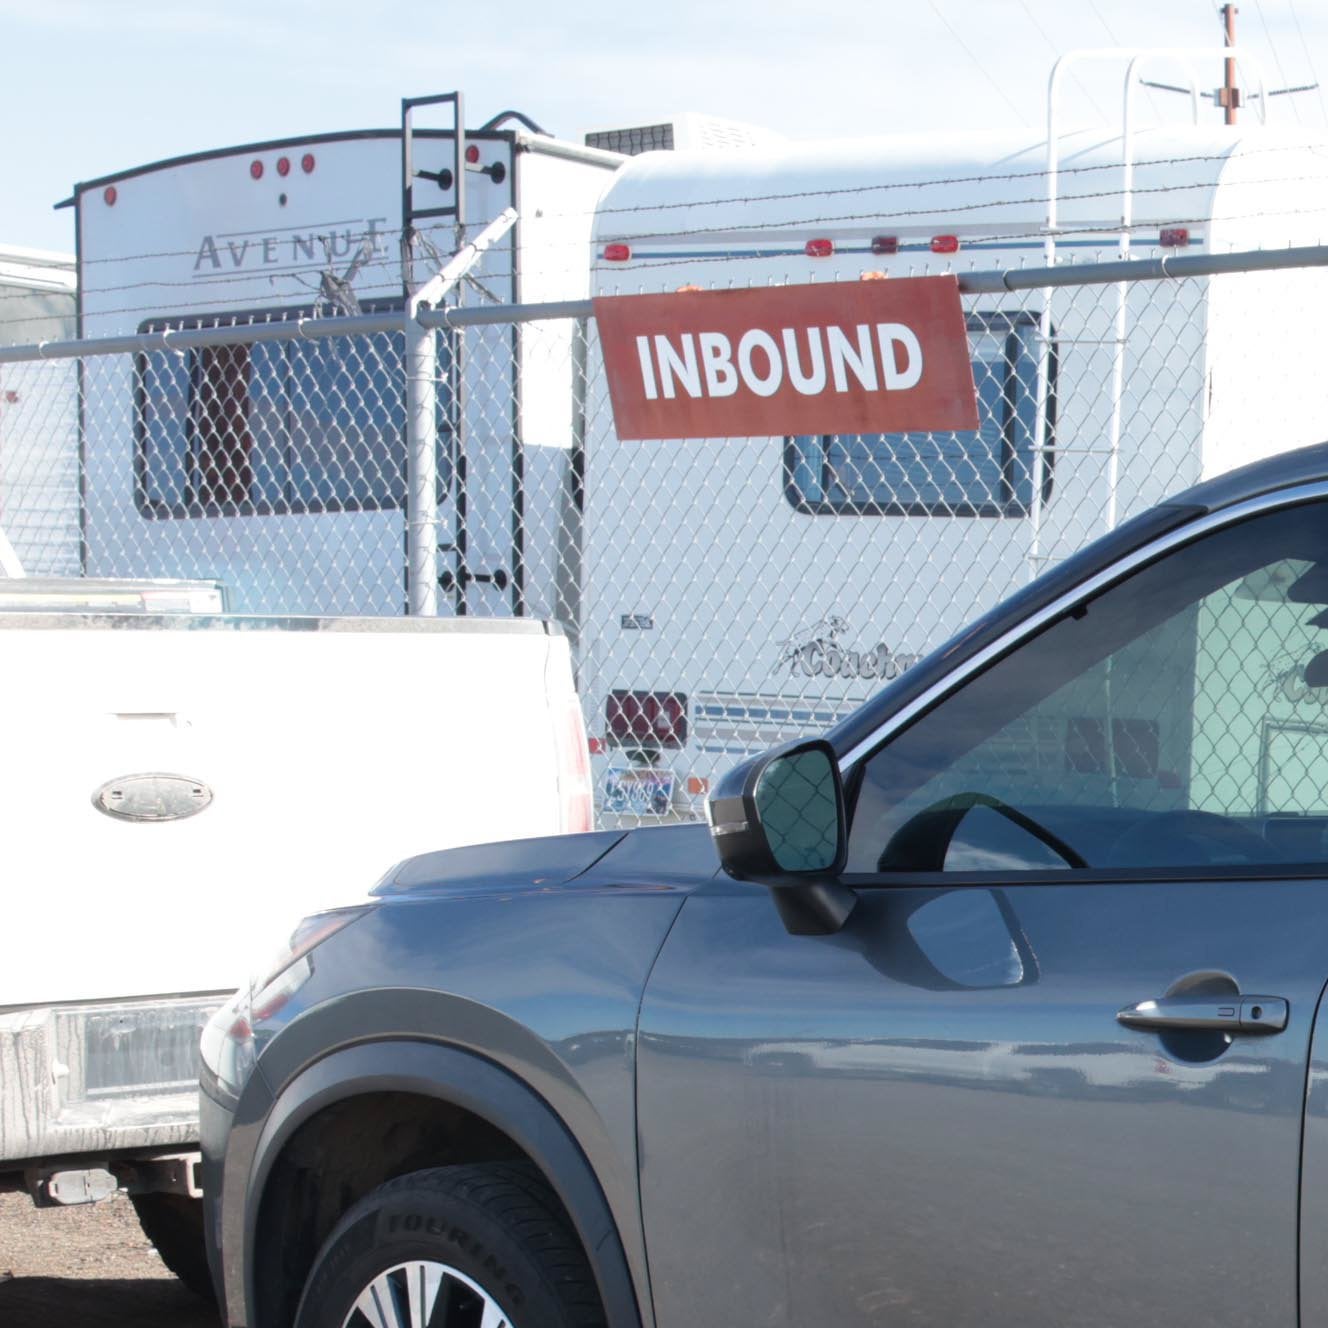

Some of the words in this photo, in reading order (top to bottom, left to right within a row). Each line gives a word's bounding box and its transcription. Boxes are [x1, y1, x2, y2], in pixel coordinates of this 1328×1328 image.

[193, 217, 389, 271] AVENUE
[635, 322, 923, 400] INBOUND
[800, 640, 923, 680] Coachm
